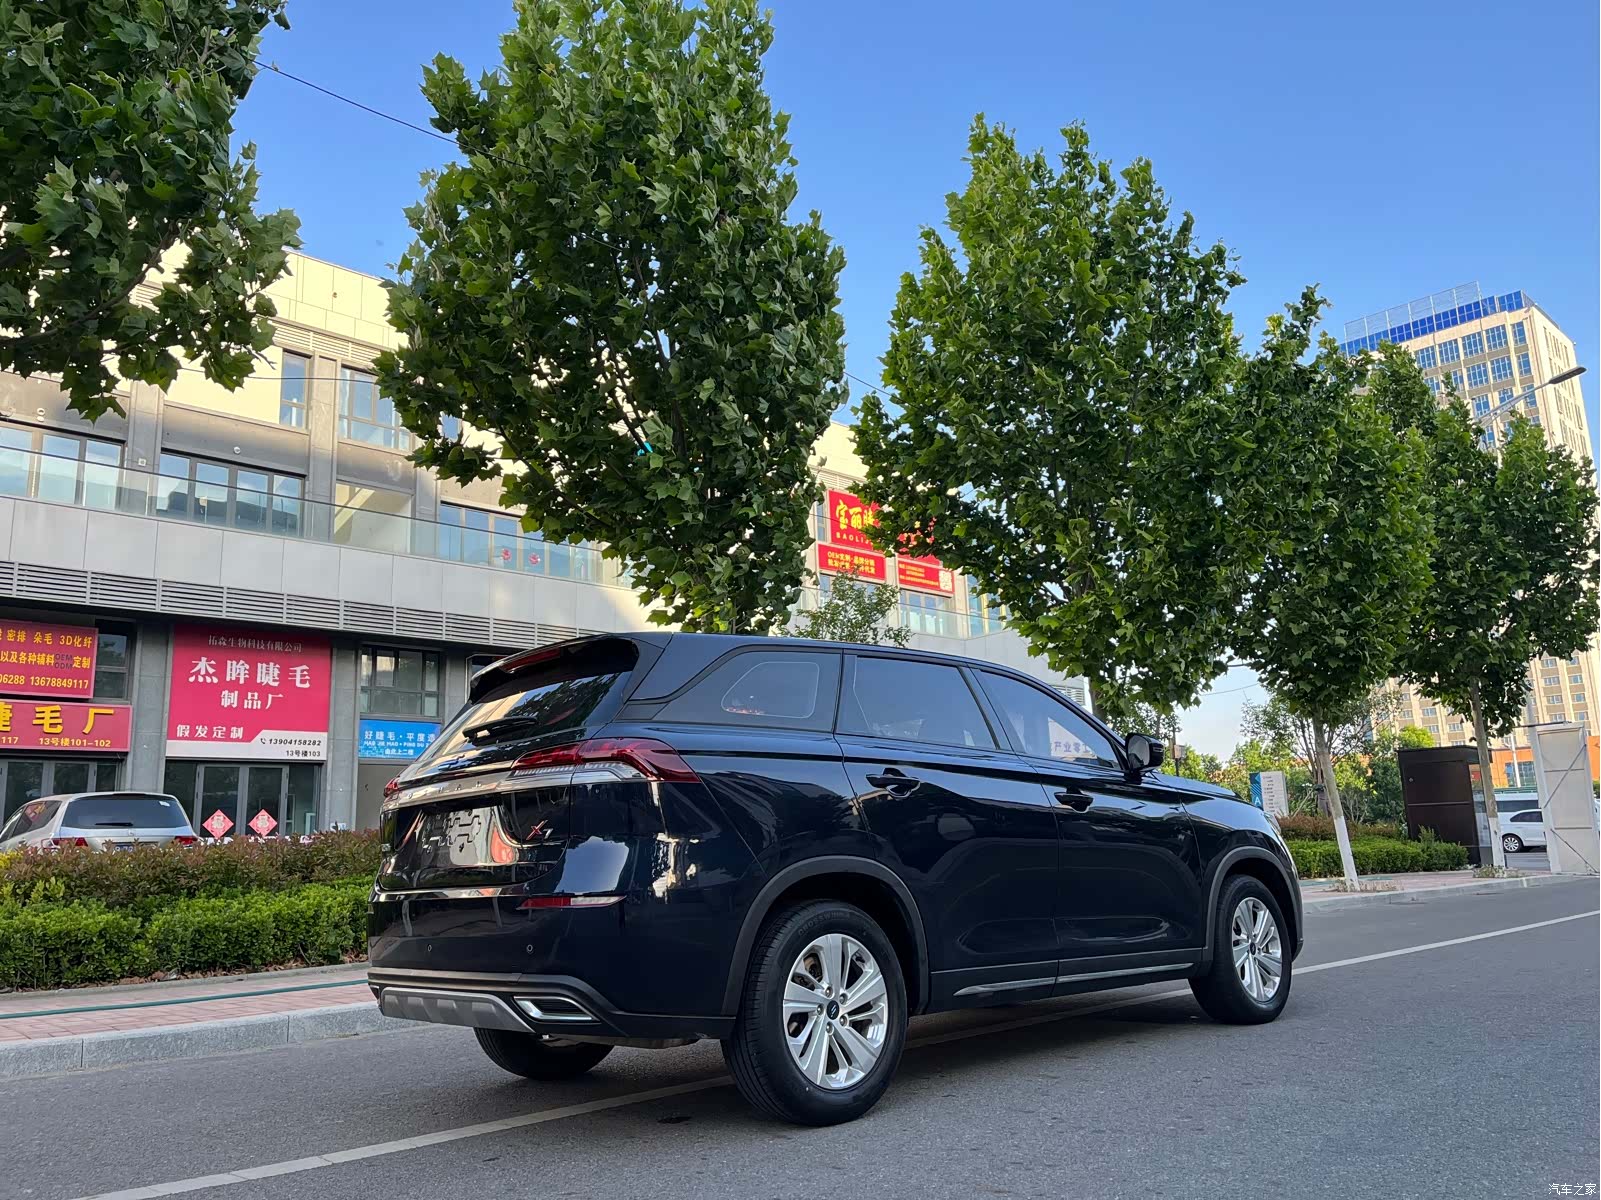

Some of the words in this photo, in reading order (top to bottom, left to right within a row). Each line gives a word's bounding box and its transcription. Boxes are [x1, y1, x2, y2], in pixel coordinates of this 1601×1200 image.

[836, 532, 874, 545] BAOLIJ
[34, 632, 53, 645] 朵毛
[59, 635, 93, 648] 3D化纤
[208, 635, 303, 653] 拓森生物科技有限公司
[0, 651, 55, 666] 以及各种辅料
[73, 656, 91, 669] 定制
[55, 653, 73, 661] OEM
[55, 662, 73, 670] ODM
[188, 657, 311, 688] 杰眸睫毛
[30, 676, 89, 689] 13678849117
[221, 690, 284, 710] 制品厂
[176, 724, 243, 739] 假发定制
[2, 736, 19, 744] 117
[39, 737, 111, 748] 13号楼101-102
[286, 749, 321, 757] 13号楼103
[1254, 796, 1262, 807] A
